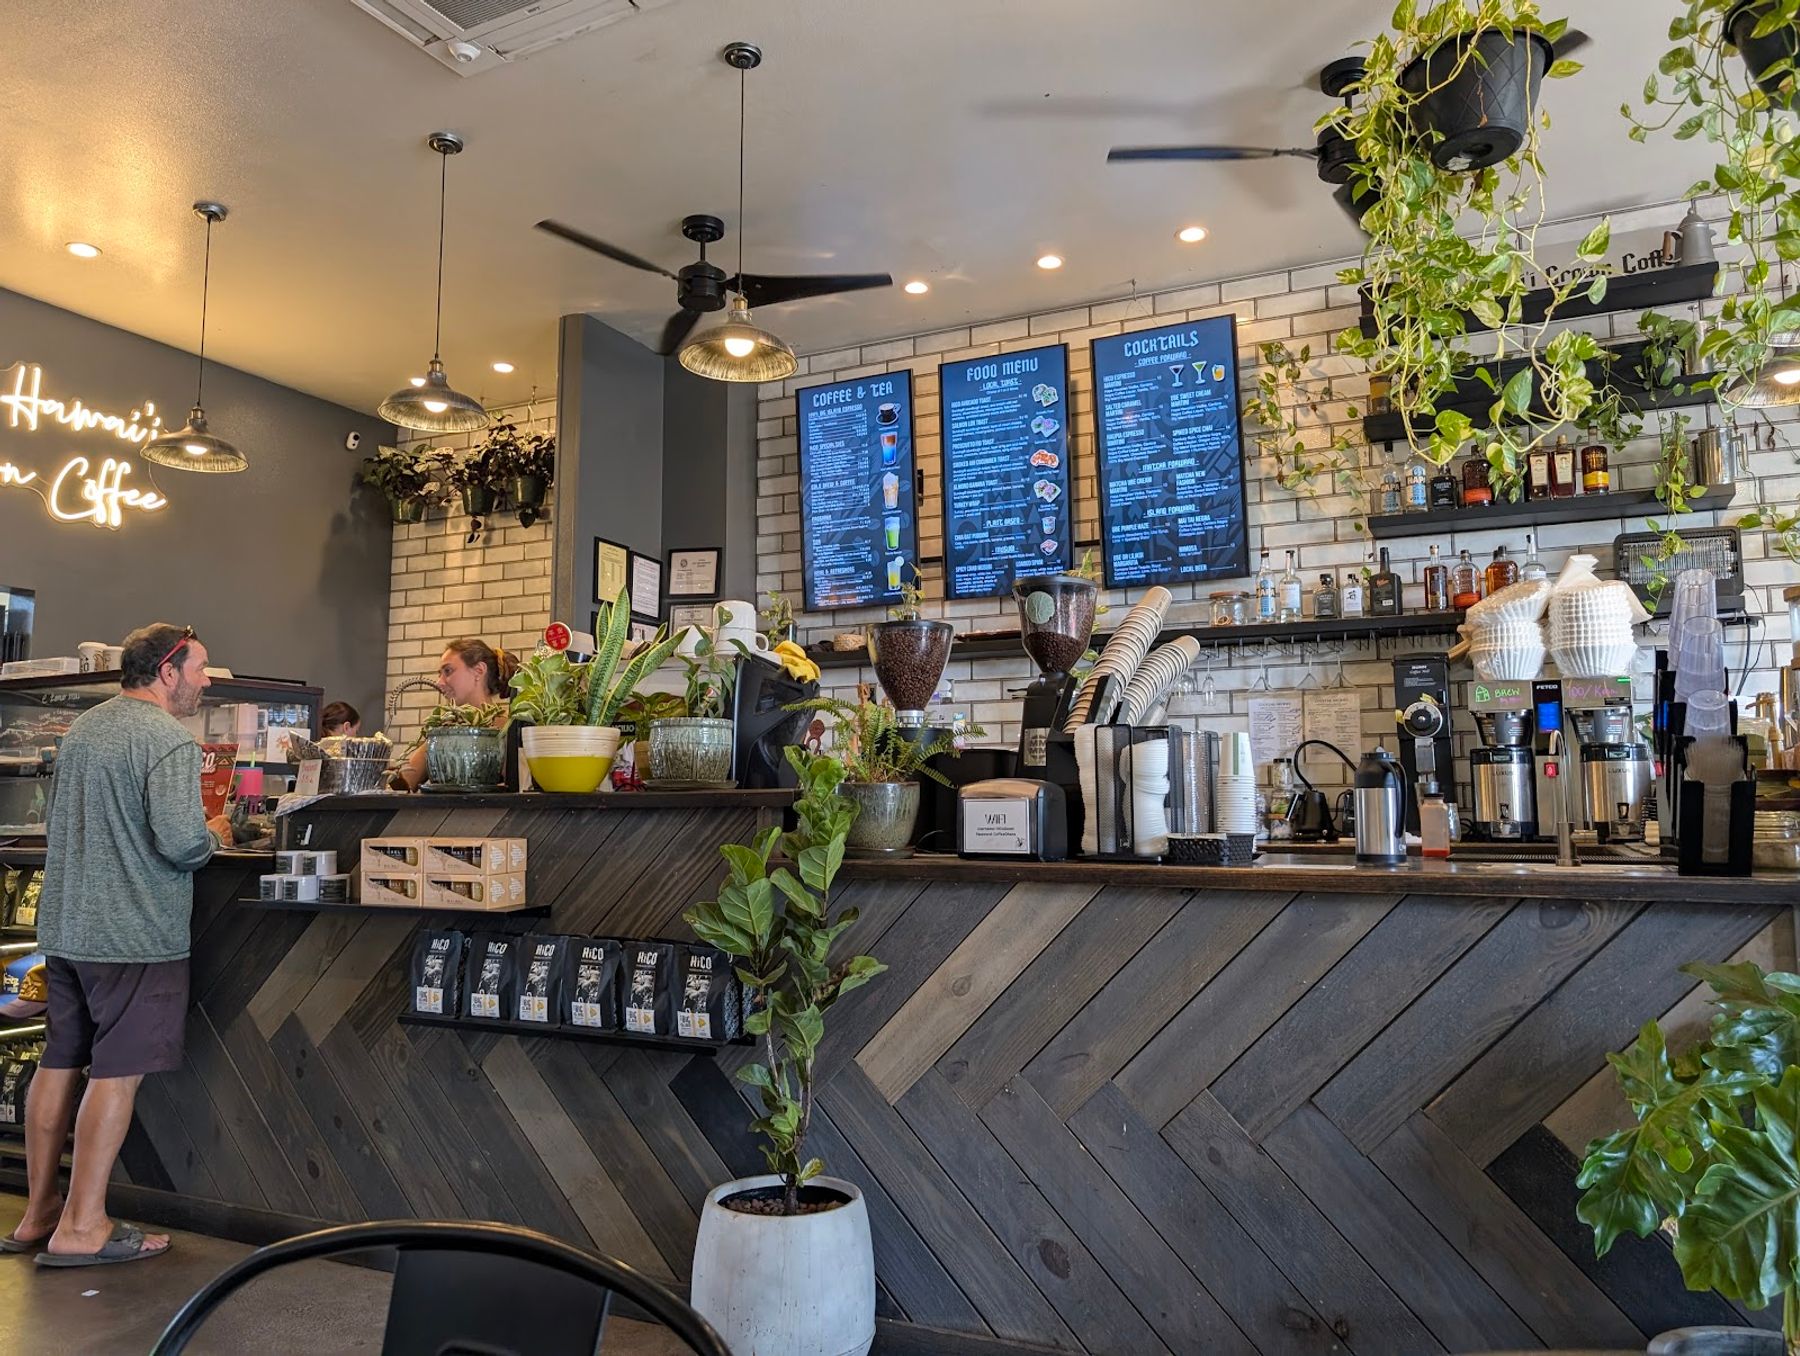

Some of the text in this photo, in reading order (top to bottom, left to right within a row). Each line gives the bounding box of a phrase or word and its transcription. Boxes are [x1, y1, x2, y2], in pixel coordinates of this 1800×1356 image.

[1124, 330, 1199, 357] COCKTAILS
[966, 357, 1038, 381] FOOD MENU
[813, 381, 893, 407] COFFEE & TEA
[51, 456, 167, 527] Coffee
[1494, 688, 1520, 698] BREW
[985, 814, 1006, 824] WIFI
